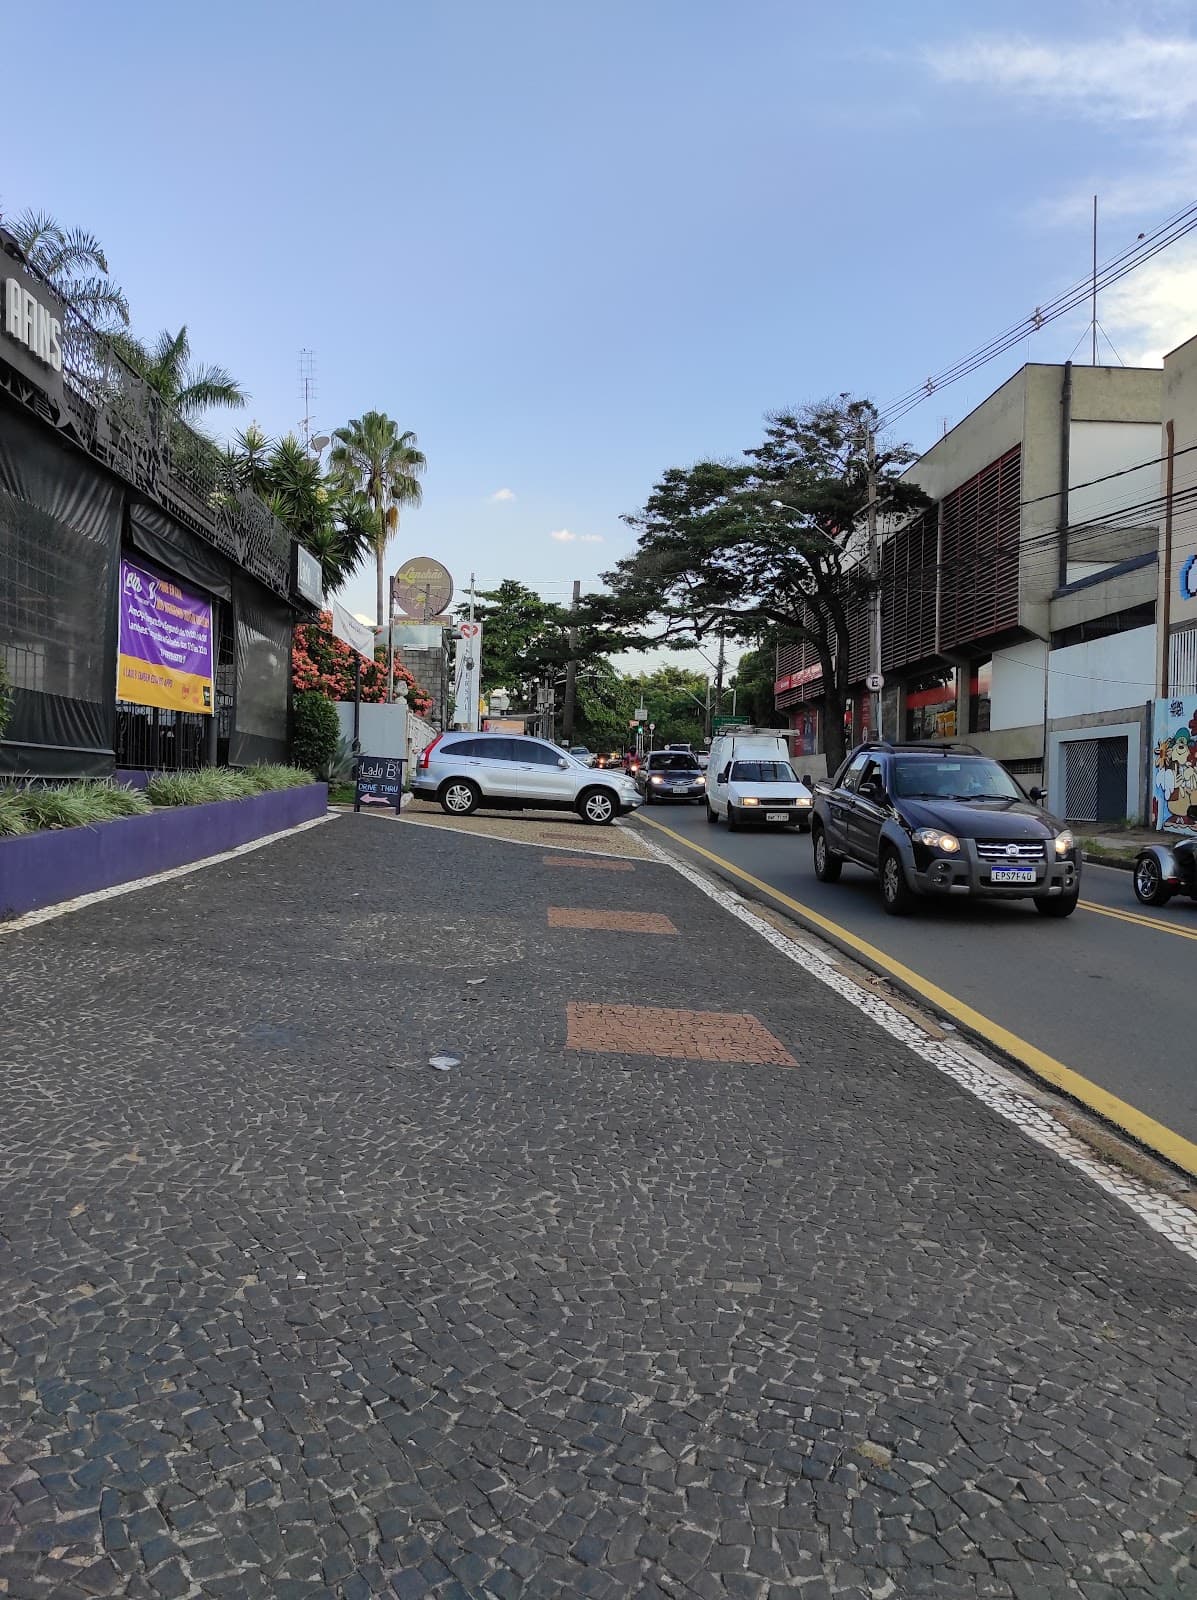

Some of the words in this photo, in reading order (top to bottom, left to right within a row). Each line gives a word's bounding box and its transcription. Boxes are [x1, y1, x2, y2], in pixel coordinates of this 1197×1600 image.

[362, 762, 383, 776] Lado
[387, 763, 396, 778] B
[359, 783, 377, 791] DRIVE
[381, 784, 398, 793] THRU
